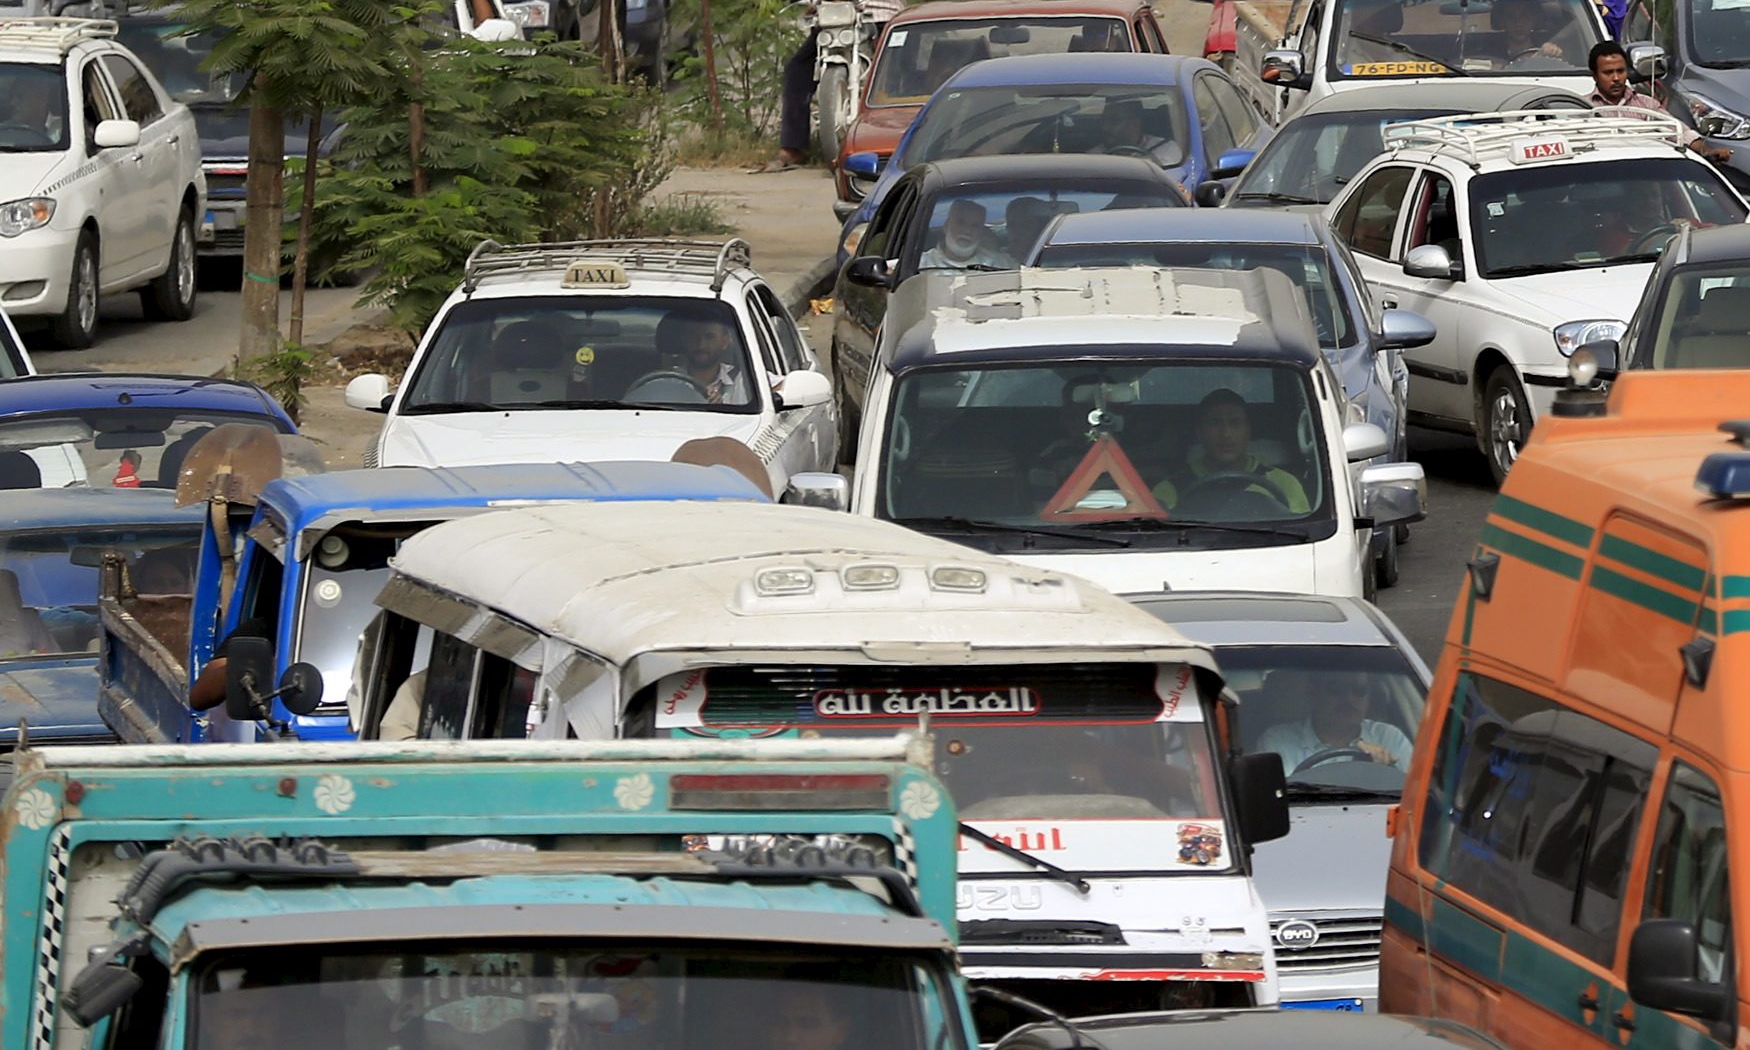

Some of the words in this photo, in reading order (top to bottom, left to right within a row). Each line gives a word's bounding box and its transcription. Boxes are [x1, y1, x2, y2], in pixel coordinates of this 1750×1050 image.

[1357, 62, 1439, 75] 76-FD-NG
[1525, 142, 1563, 158] TAXI
[571, 269, 615, 283] TAXI
[818, 689, 871, 714] لله
[882, 687, 1035, 714] العظمة
[957, 886, 1042, 911] UZU
[1283, 929, 1312, 940] BYD
